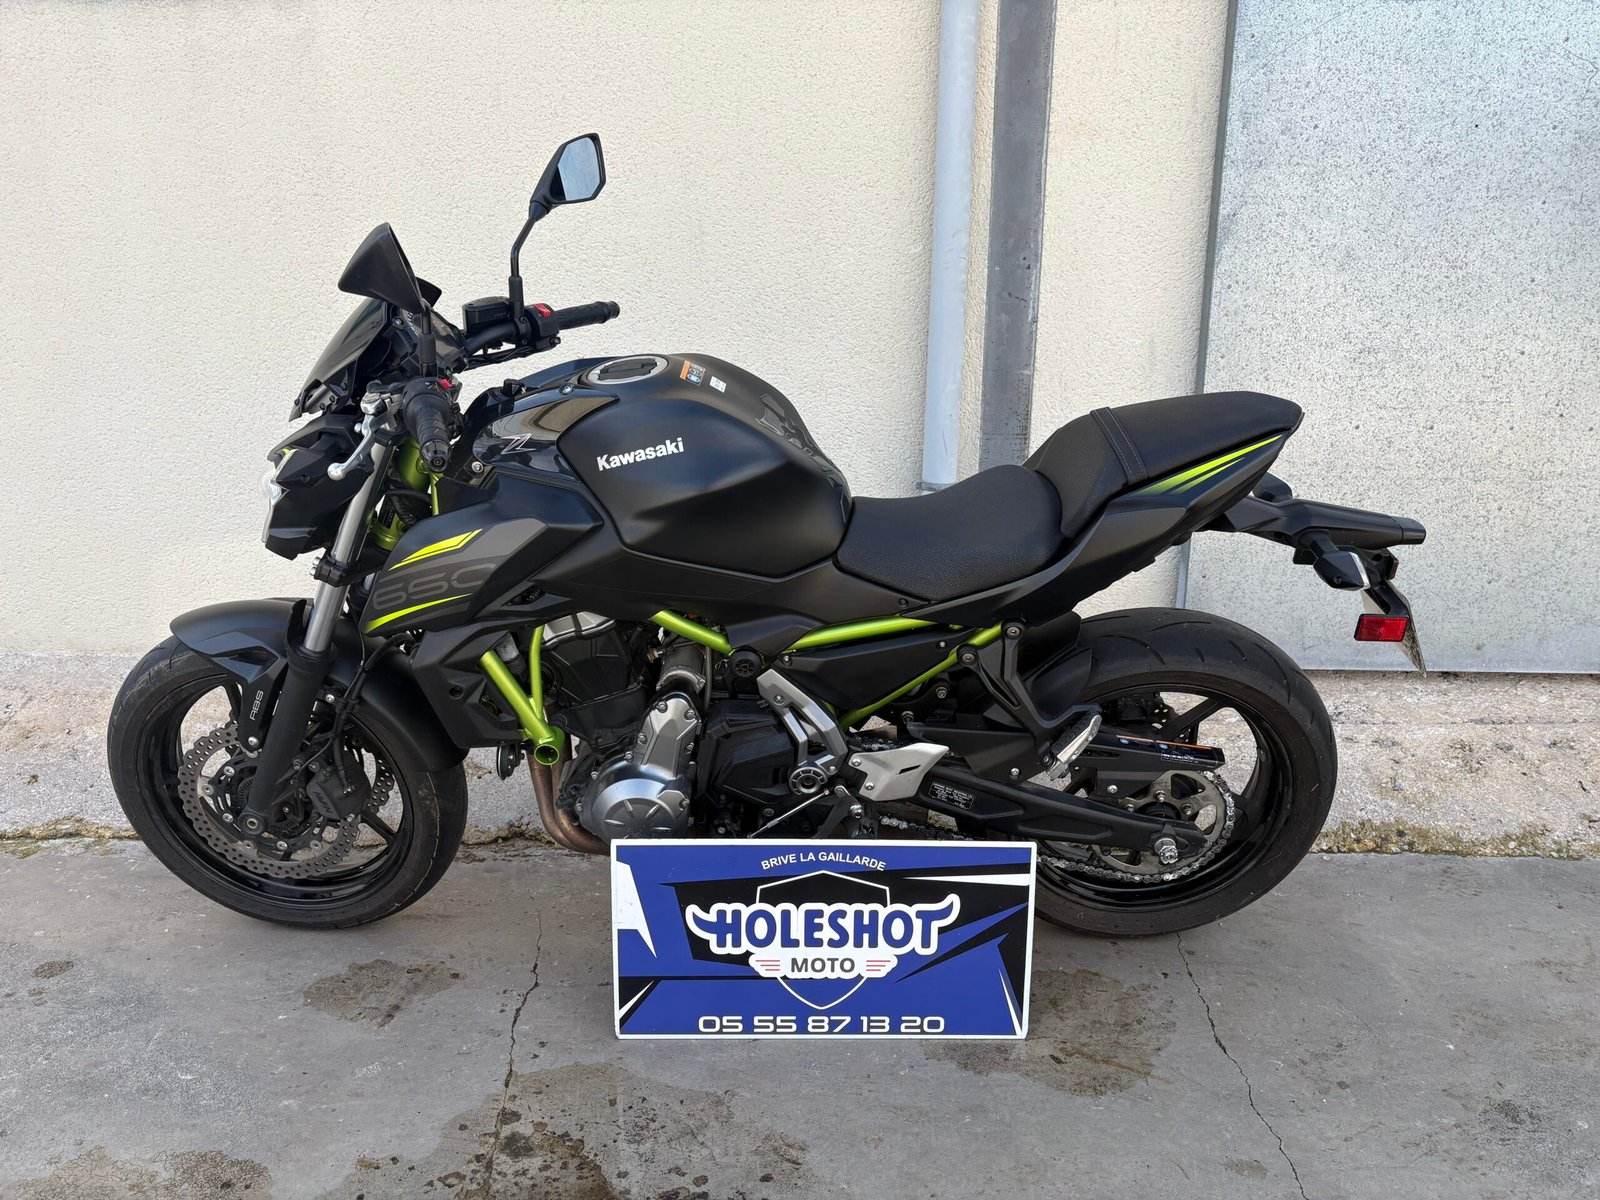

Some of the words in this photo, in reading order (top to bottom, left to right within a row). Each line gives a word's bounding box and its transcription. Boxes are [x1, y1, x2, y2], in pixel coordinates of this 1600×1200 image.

[596, 437, 684, 472] Kawasaki
[249, 689, 264, 721] ABS
[761, 853, 797, 870] BRIVE
[800, 852, 816, 862] LA
[818, 851, 887, 872] GAILLARDE
[692, 899, 954, 949] HOLESHOT
[790, 957, 856, 973] MOTO
[698, 1016, 743, 1033] 05
[753, 1016, 798, 1033] 55
[807, 1016, 851, 1033] 87
[860, 1016, 890, 1033] 13
[900, 1016, 945, 1033] 20
